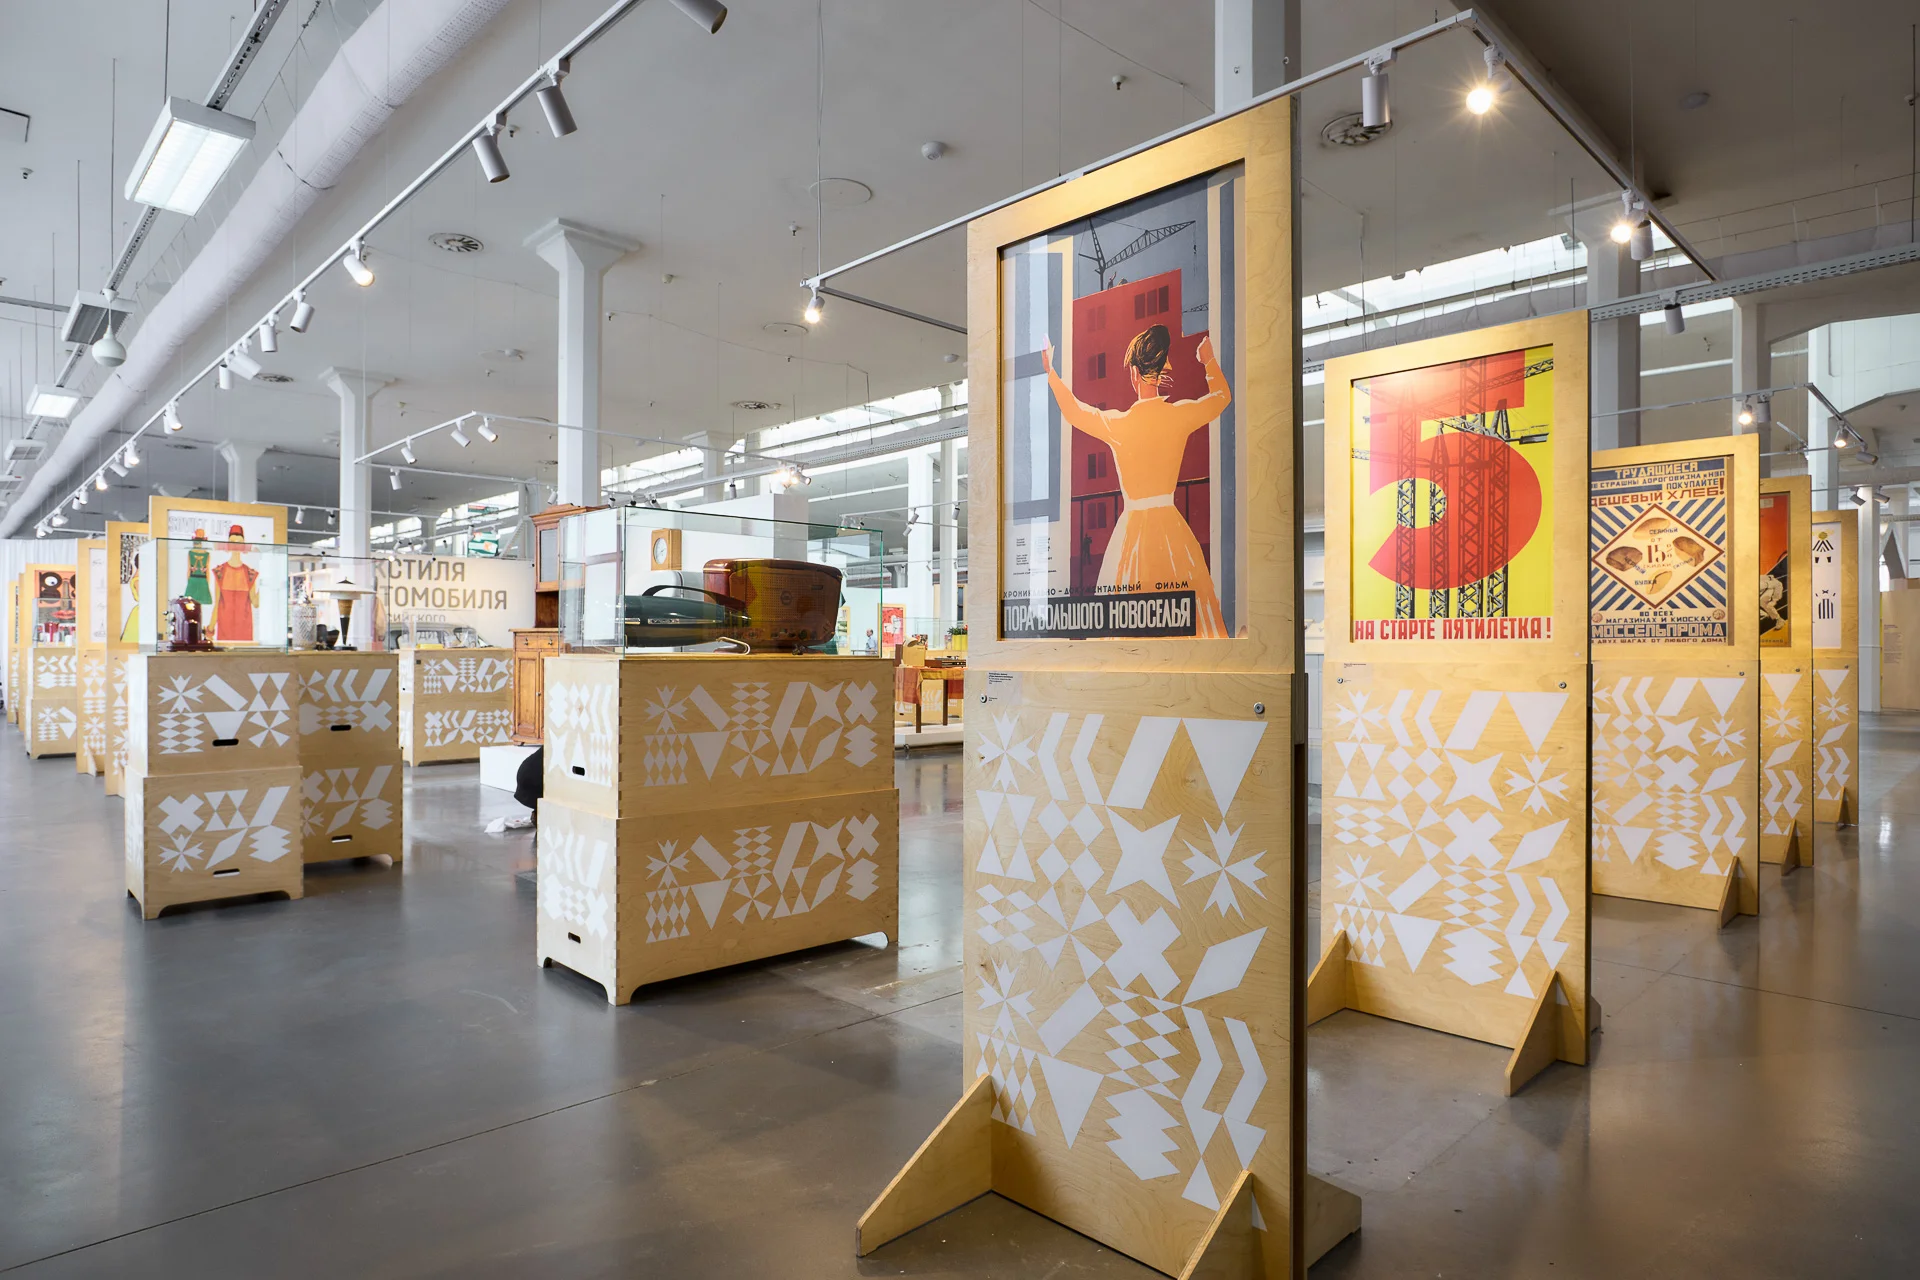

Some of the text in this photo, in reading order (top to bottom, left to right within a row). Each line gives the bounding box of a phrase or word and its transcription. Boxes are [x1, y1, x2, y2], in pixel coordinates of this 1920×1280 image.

[1615, 461, 1699, 479] ТРУДЯЩИЕСЯ
[1601, 479, 1639, 488] СТРАШНЫ
[1642, 473, 1701, 484] ДОРОГОВИЗНА
[1667, 477, 1719, 490] ПОКУПАЙТЕ
[1667, 477, 1725, 500] ХЛЕБ!
[1155, 580, 1189, 590] ФИЛЬМ
[379, 585, 508, 610] ТОМОБИЛЯ
[1004, 597, 1191, 632] ПОРА БОЛЬШОГО НОВОСЕЛЬЯ
[1354, 620, 1375, 640] НА
[1380, 619, 1436, 640] СТАРТЕ
[1591, 623, 1724, 638] МОССЕЛЬПРОМА
